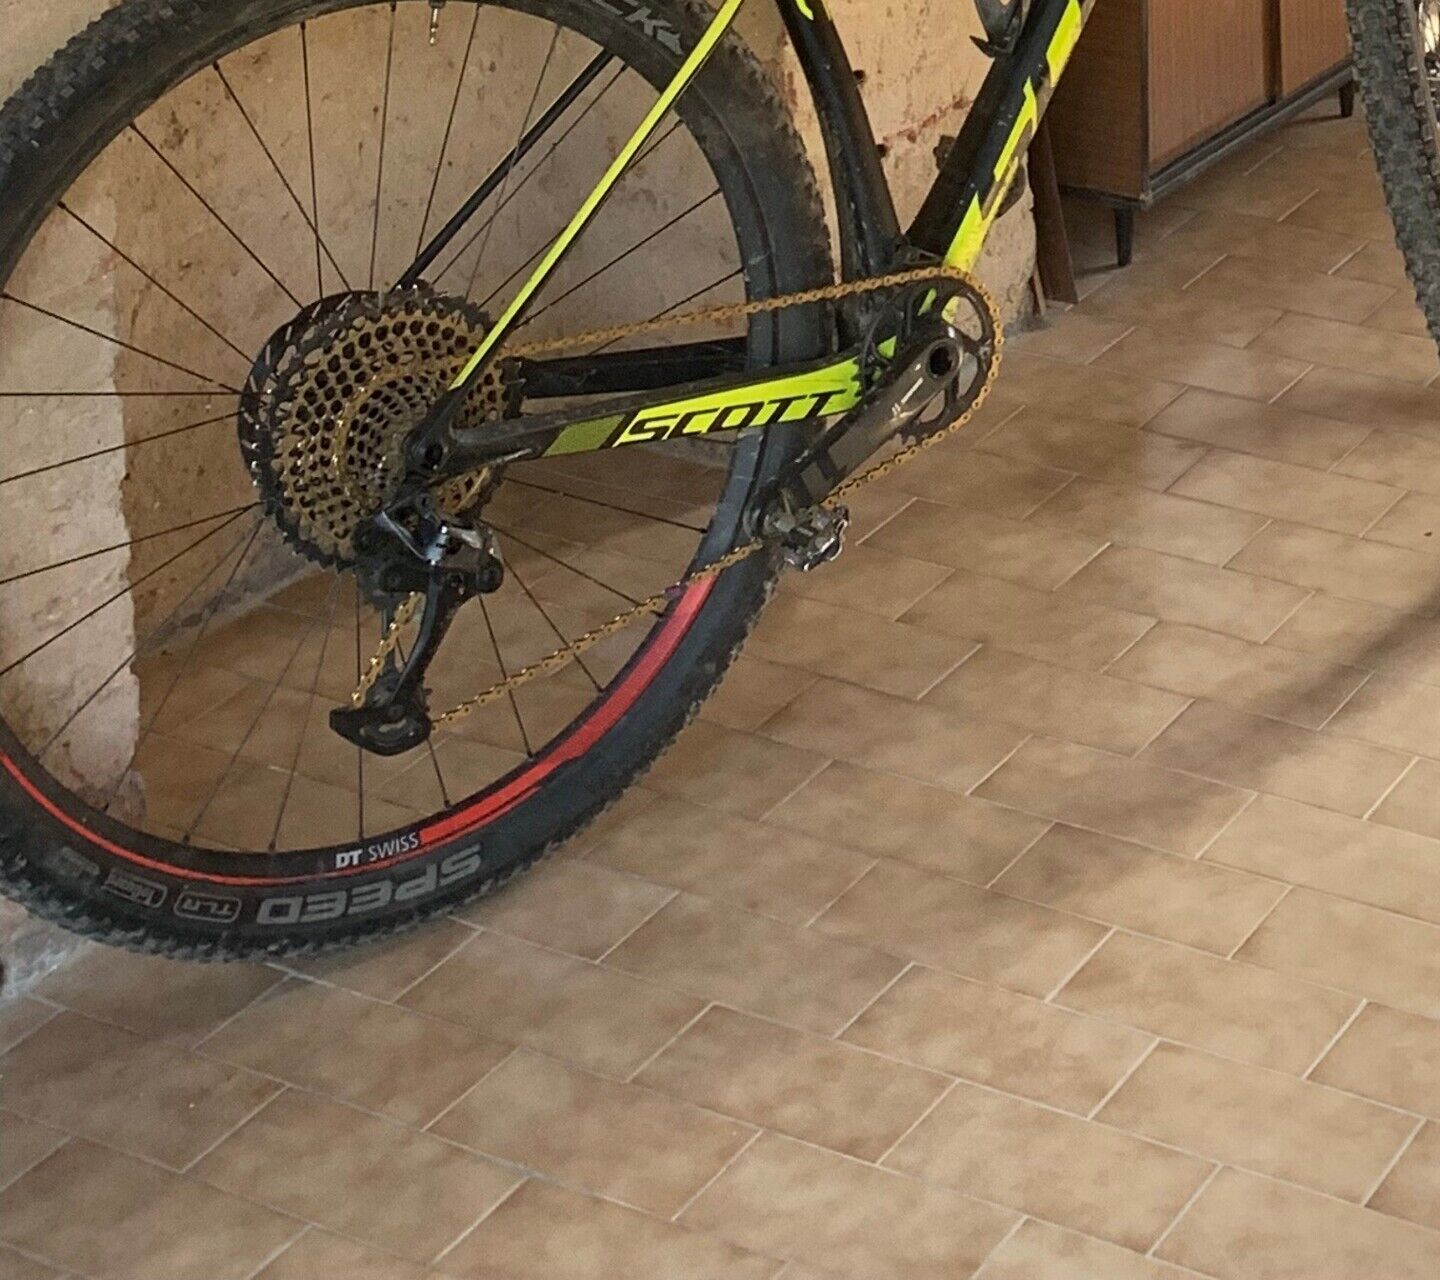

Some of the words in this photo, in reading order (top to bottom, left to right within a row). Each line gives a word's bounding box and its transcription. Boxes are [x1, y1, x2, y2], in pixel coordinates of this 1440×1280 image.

[613, 388, 849, 448] SCOTT
[335, 848, 363, 869] DT
[367, 831, 420, 863] SWISS
[180, 896, 235, 920] TLR
[256, 843, 484, 926] SPEED
